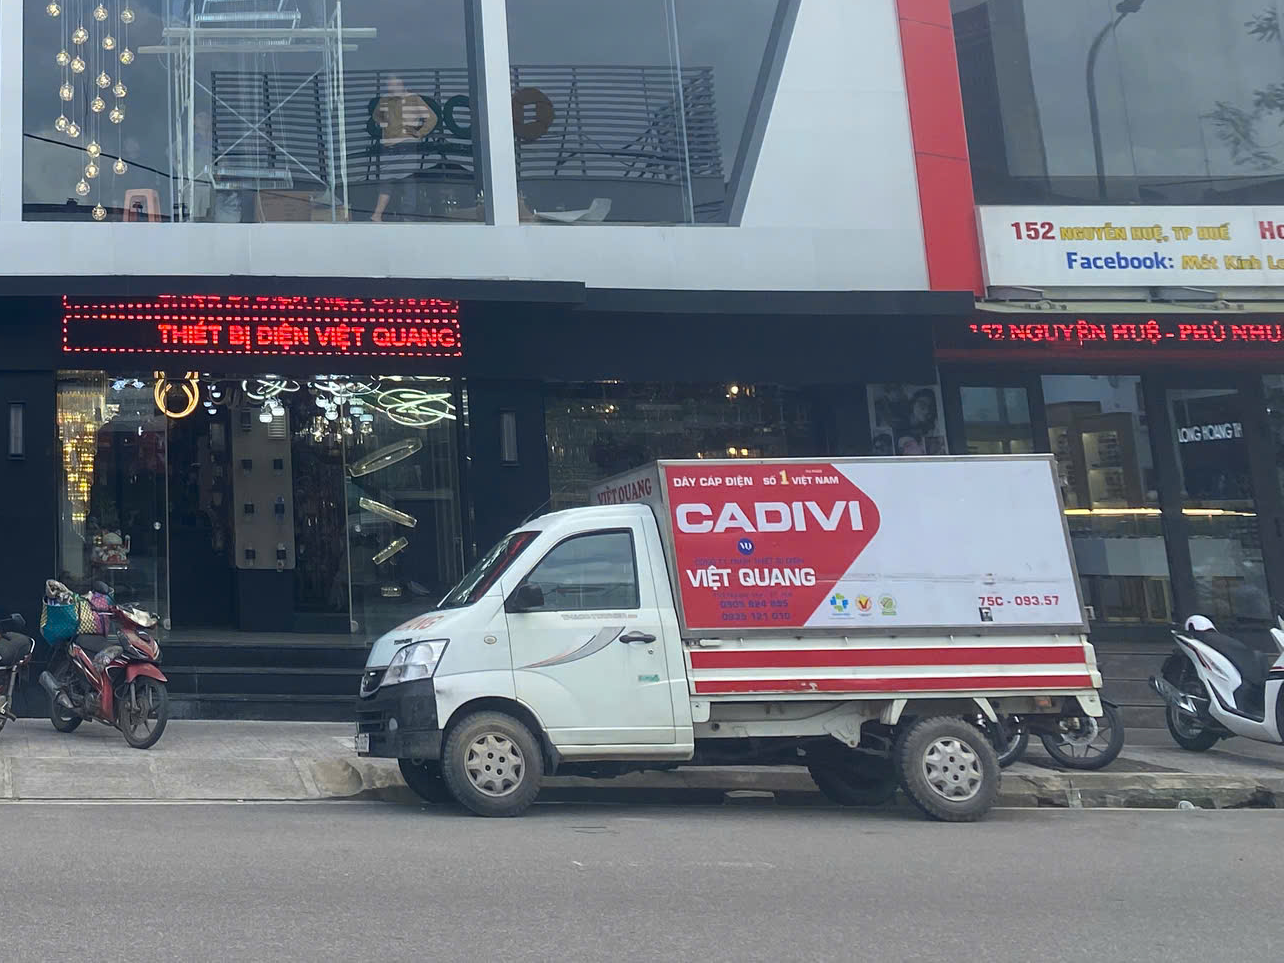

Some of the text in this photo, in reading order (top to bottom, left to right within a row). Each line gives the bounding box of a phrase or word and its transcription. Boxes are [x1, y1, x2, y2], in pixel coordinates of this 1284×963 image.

[1011, 221, 1055, 240] 152
[1172, 225, 1192, 241] TP
[1066, 251, 1174, 270] Facebook:
[158, 318, 456, 350] THIẾT BỊ ĐIỆN VIỆT QUANG
[673, 475, 754, 488] DÂY CÁP ĐIỆN
[779, 469, 790, 485] 1
[792, 474, 813, 486] VIỆT
[815, 475, 839, 485] NAM
[676, 500, 864, 534] CADIVI
[686, 564, 816, 591] VIỆT QUANG
[978, 595, 1004, 607] 75C
[1014, 594, 1060, 606] 093.57
